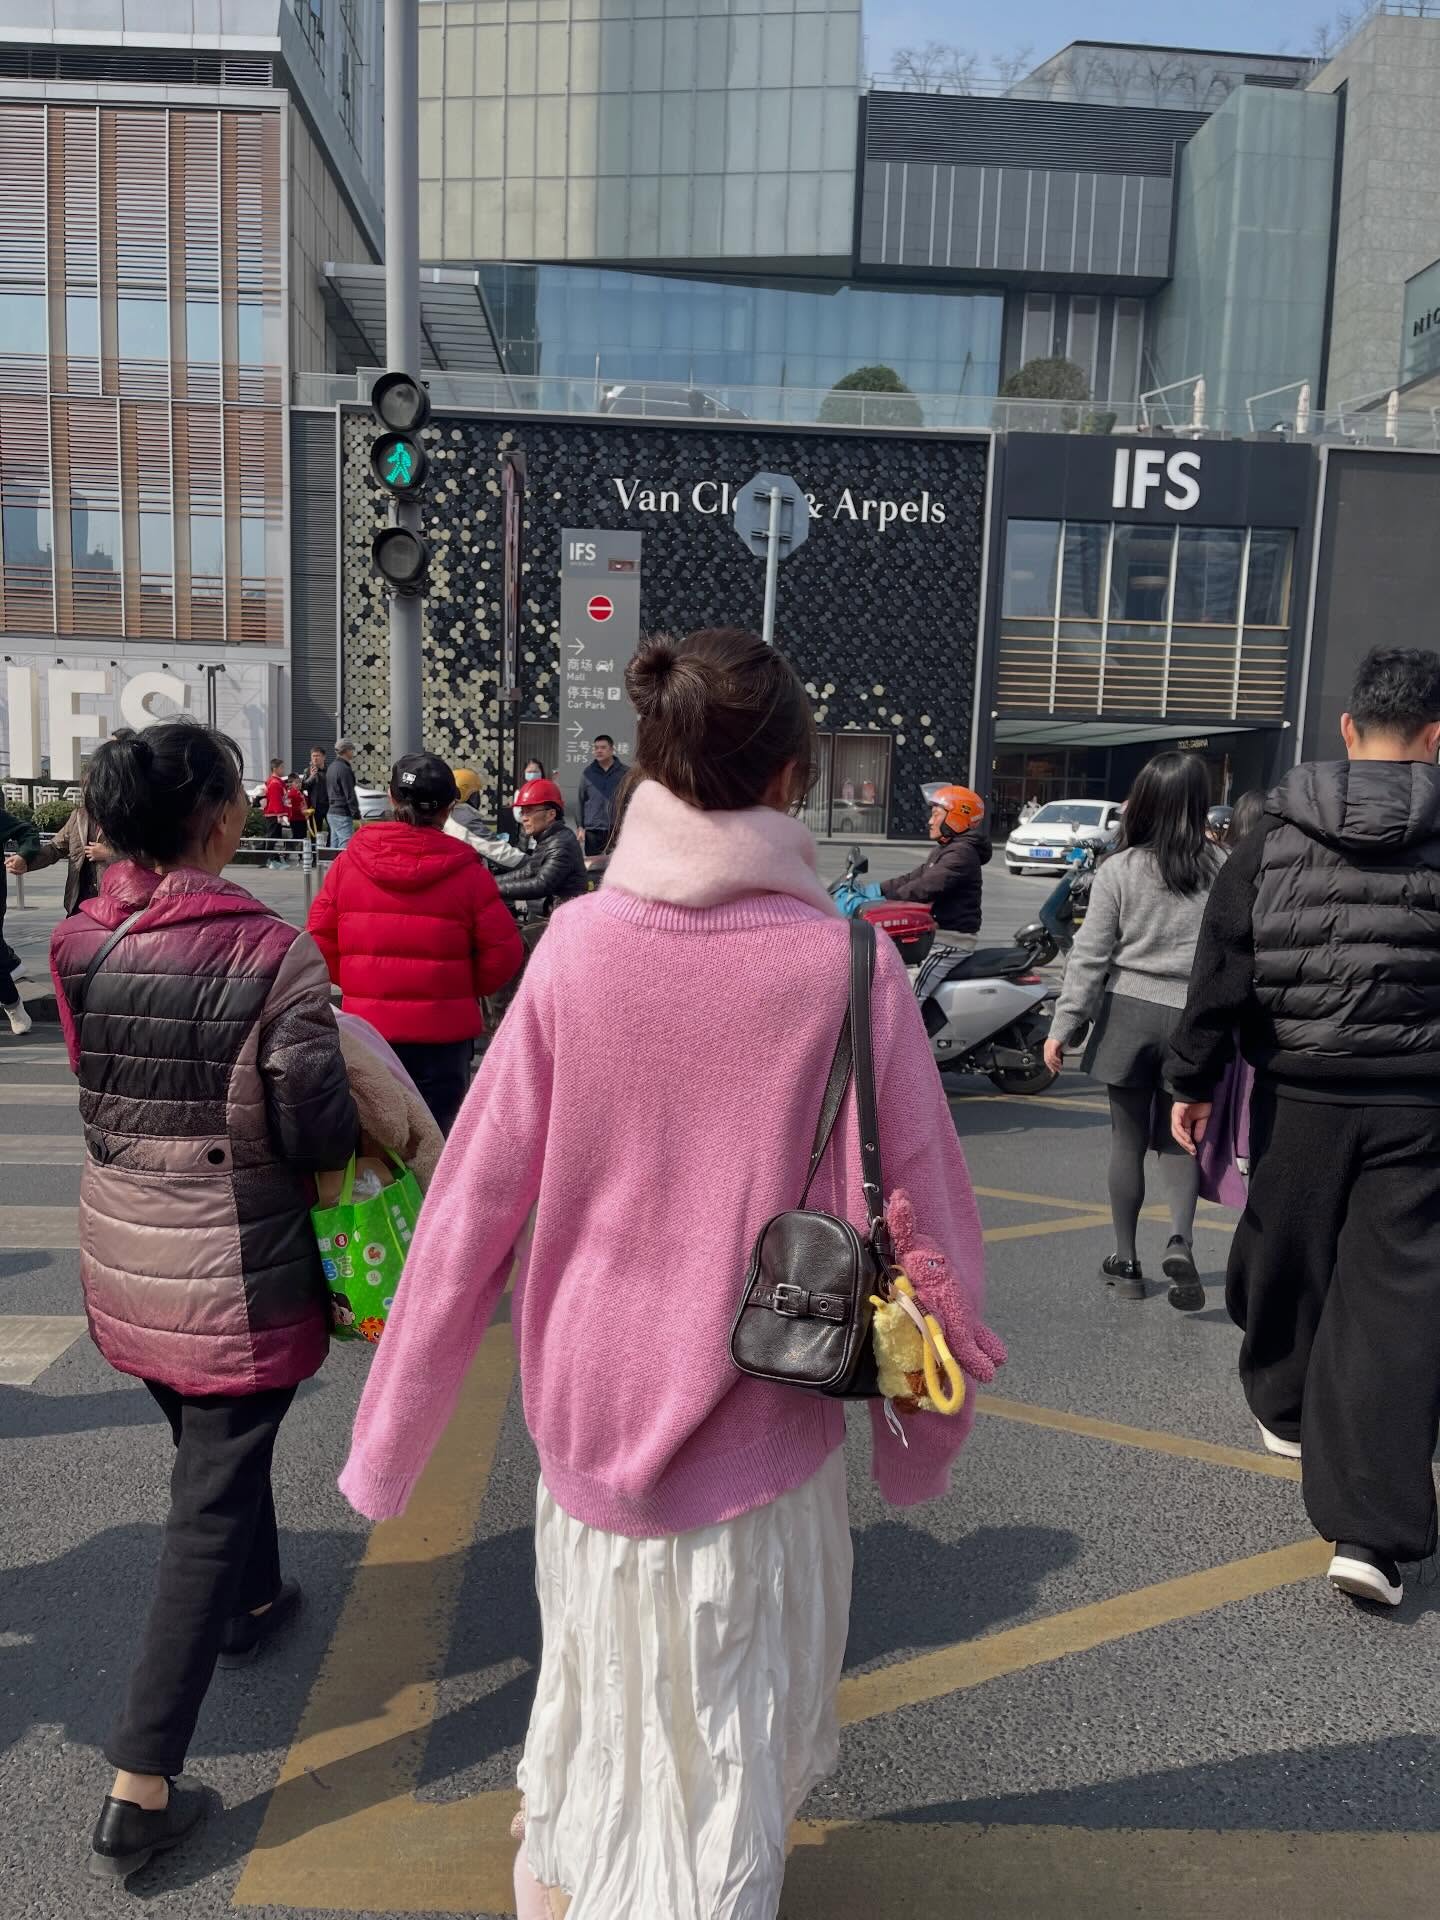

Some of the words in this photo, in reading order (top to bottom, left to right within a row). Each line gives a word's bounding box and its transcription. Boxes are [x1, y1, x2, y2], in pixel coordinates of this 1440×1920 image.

[1112, 448, 1201, 511] IFS
[612, 478, 680, 512] Van
[833, 487, 946, 532] Arpels
[569, 542, 596, 561] IFS
[567, 658, 593, 671] 商场
[566, 672, 585, 681] Mall
[567, 686, 605, 700] 停车场
[567, 700, 583, 709] Car
[585, 701, 607, 711] Park
[573, 754, 589, 764] IFS
